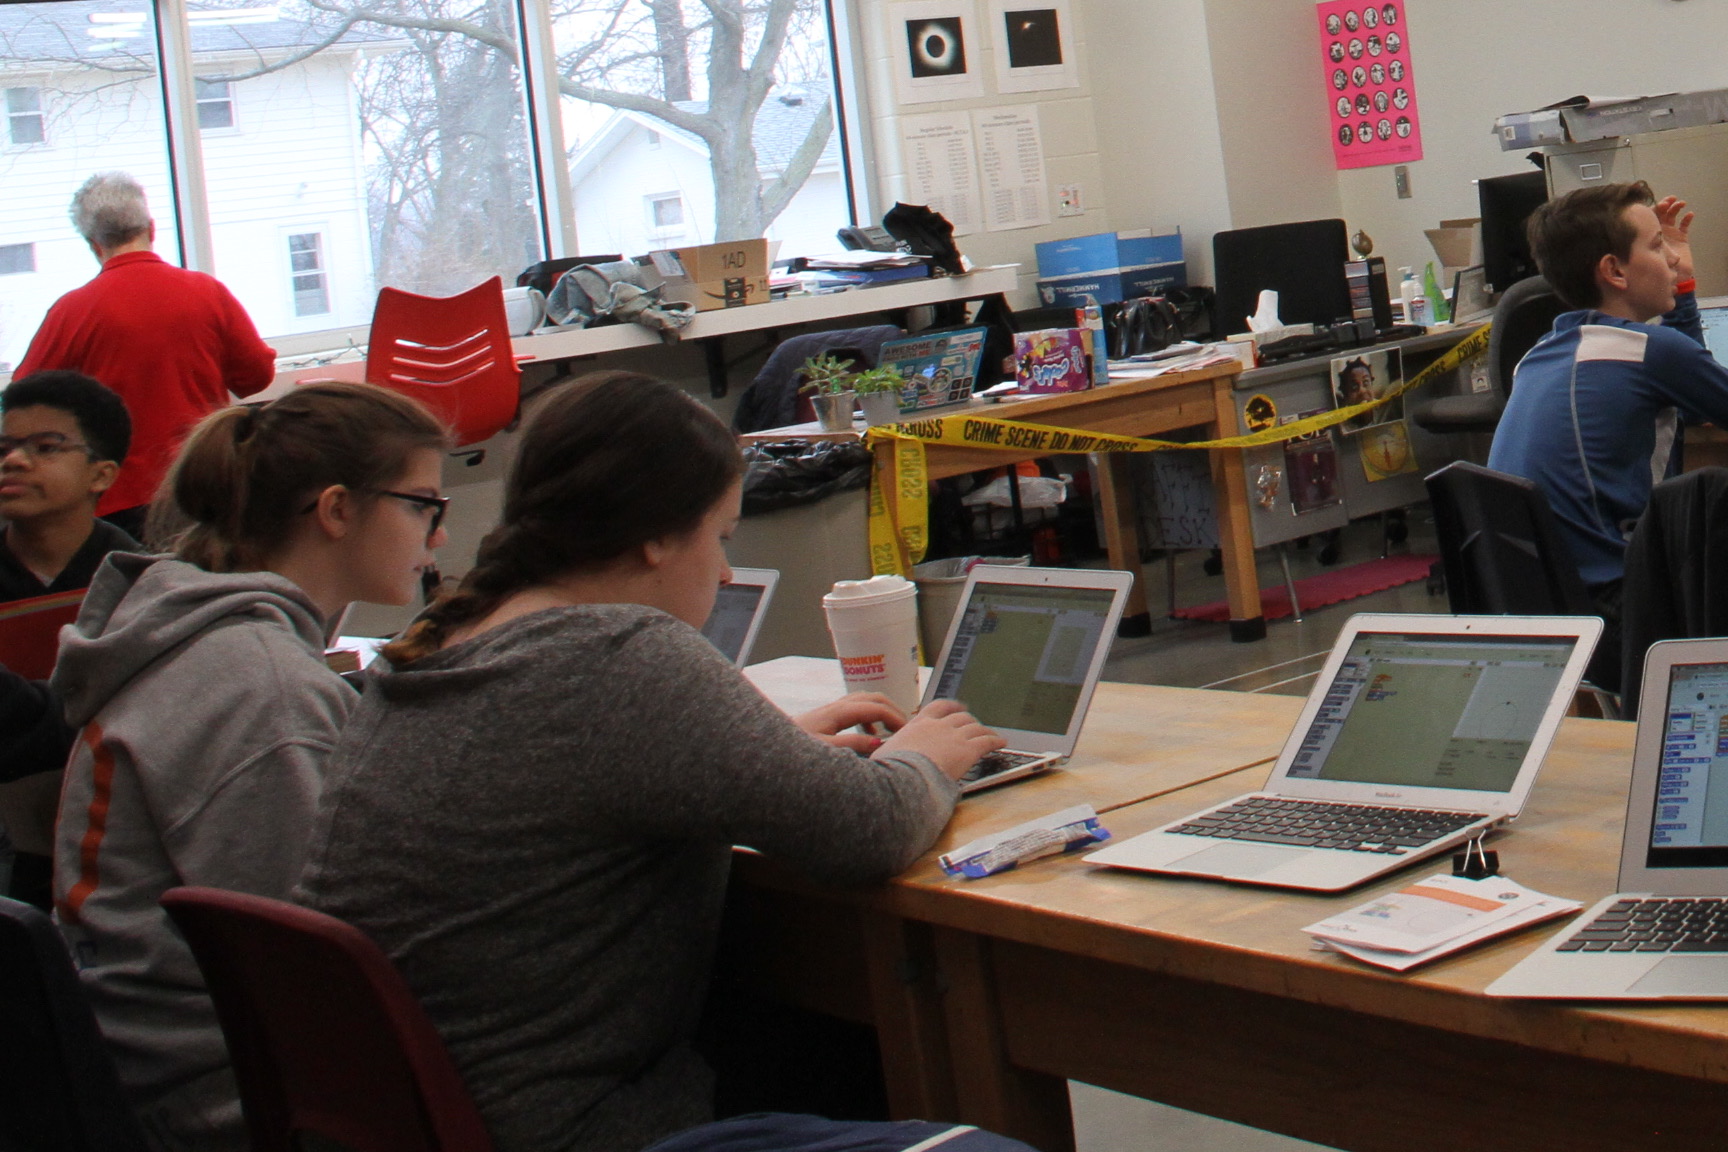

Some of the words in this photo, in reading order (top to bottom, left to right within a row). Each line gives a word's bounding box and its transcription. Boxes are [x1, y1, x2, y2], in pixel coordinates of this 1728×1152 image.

[721, 251, 746, 269] 1AD
[1457, 334, 1482, 362] CRIME
[963, 419, 1003, 446] CRIME
[1007, 426, 1049, 450] SCENE
[1049, 431, 1069, 450] DO
[1069, 435, 1096, 451] NOT
